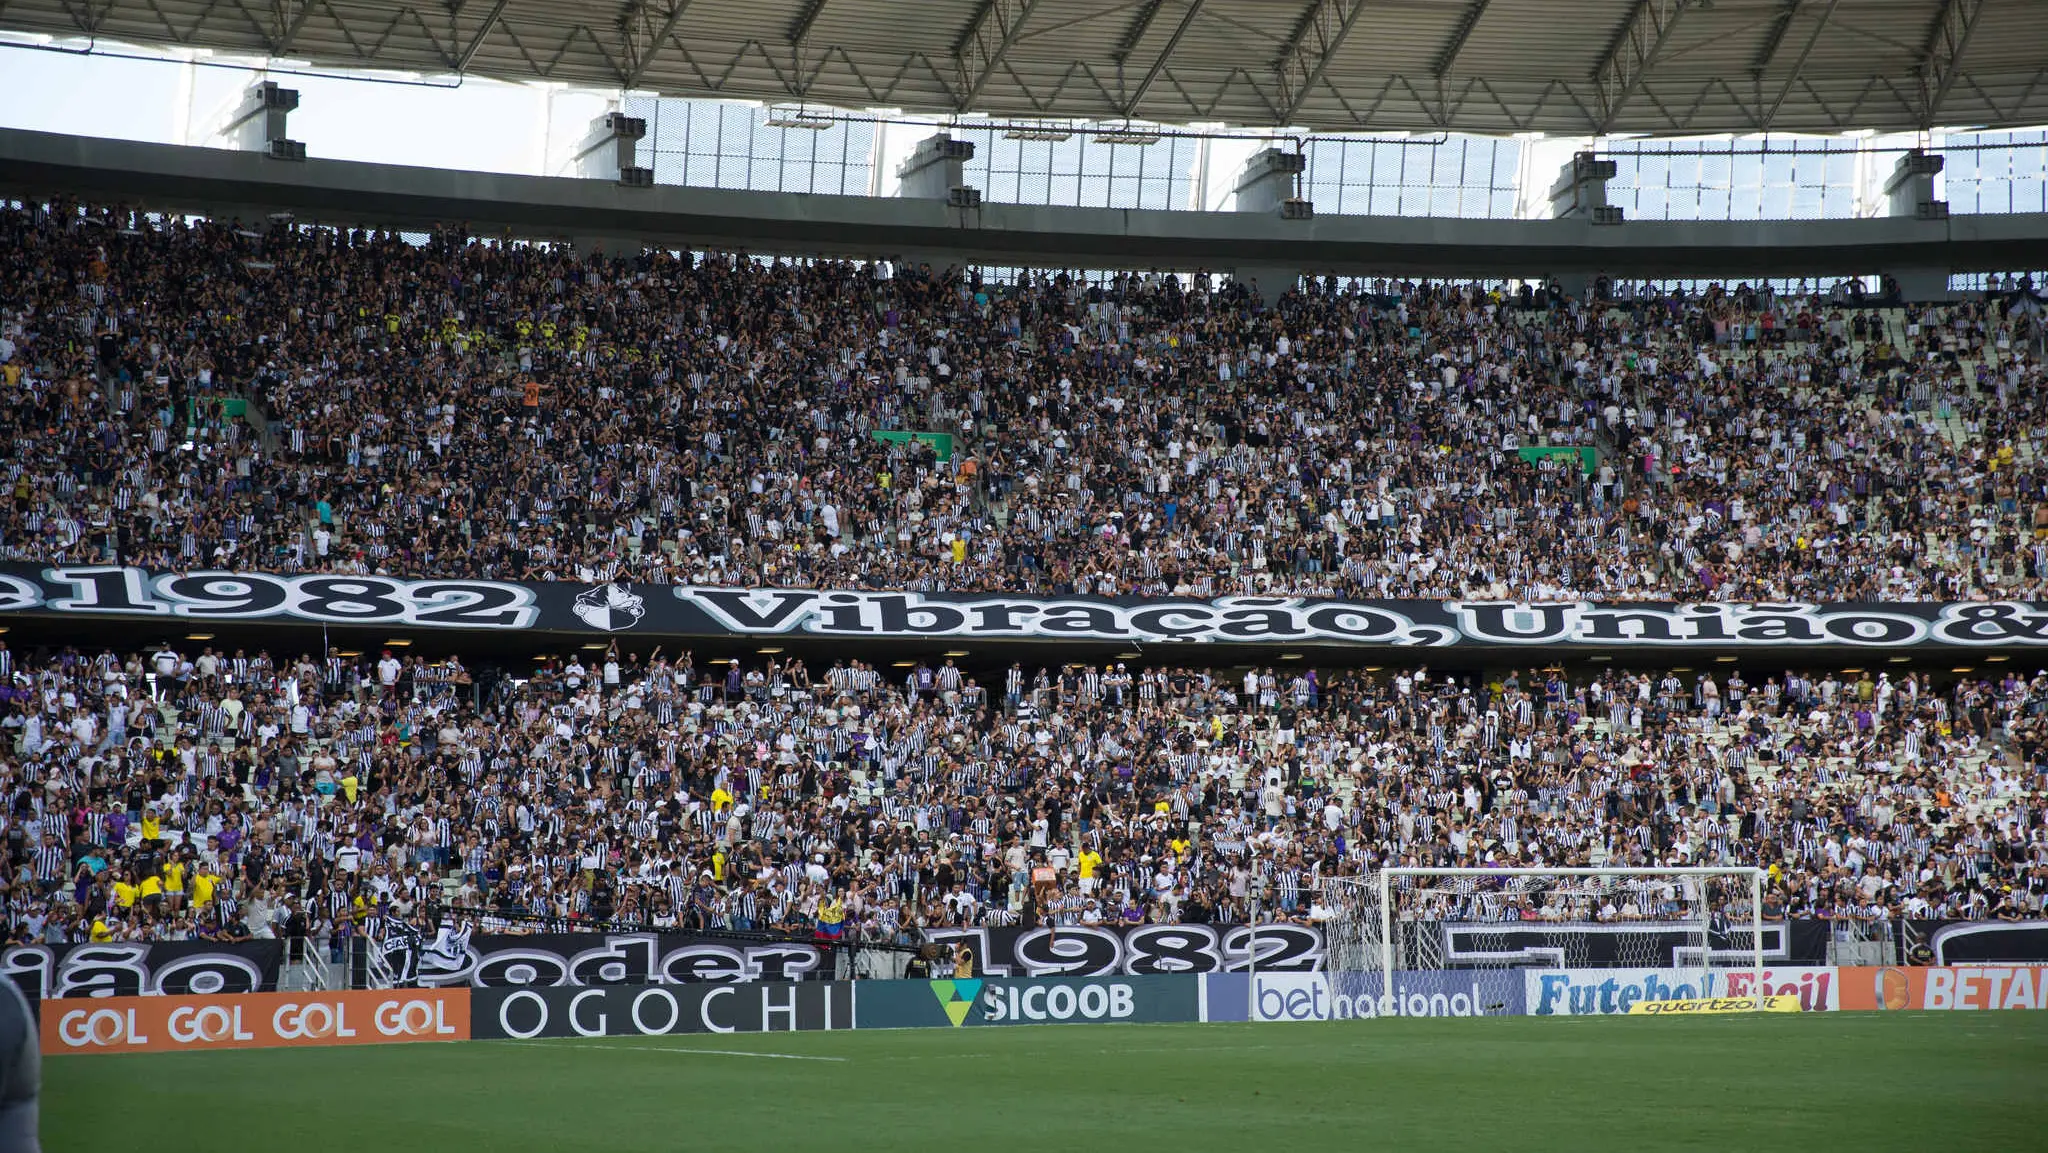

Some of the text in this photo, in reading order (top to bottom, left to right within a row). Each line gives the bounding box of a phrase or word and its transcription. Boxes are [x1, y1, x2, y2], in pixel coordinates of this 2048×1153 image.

[42, 565, 539, 628] 1982
[675, 585, 2048, 646] Vibração, União &
[923, 925, 1328, 978] 1982
[58, 999, 455, 1047] GOL GOL GOL GOL
[499, 985, 832, 1039] OGOCHI
[983, 984, 1135, 1021] SICOOB
